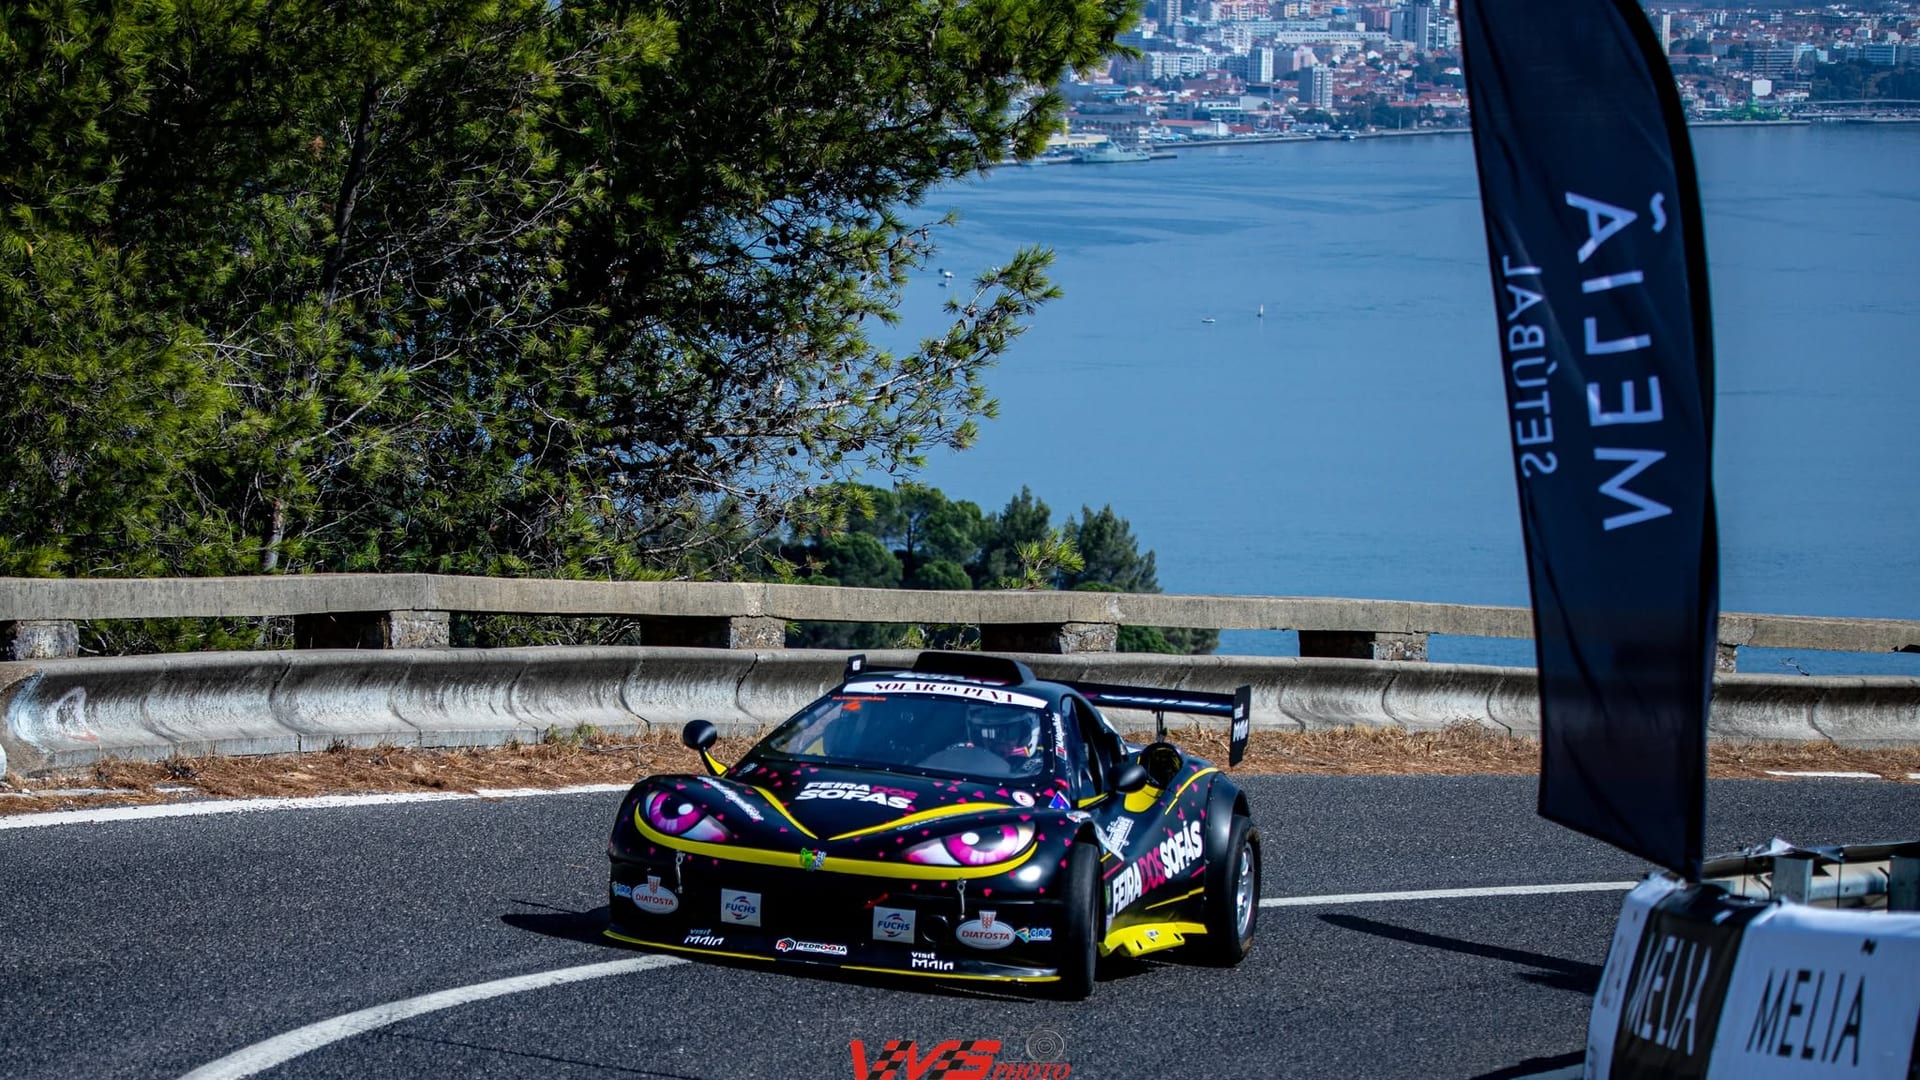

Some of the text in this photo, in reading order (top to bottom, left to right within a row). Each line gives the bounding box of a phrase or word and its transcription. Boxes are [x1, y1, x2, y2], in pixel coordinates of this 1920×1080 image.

[804, 782, 918, 800] FEIRA DOS
[1112, 861, 1142, 918] FEIRA
[1138, 847, 1167, 895] DOS
[1160, 820, 1203, 880] SOFÁS
[635, 893, 674, 907] DIATOSTA
[725, 902, 757, 914] FUCHS
[877, 920, 911, 931] FUCHS
[961, 930, 1011, 941] DIATOSTA
